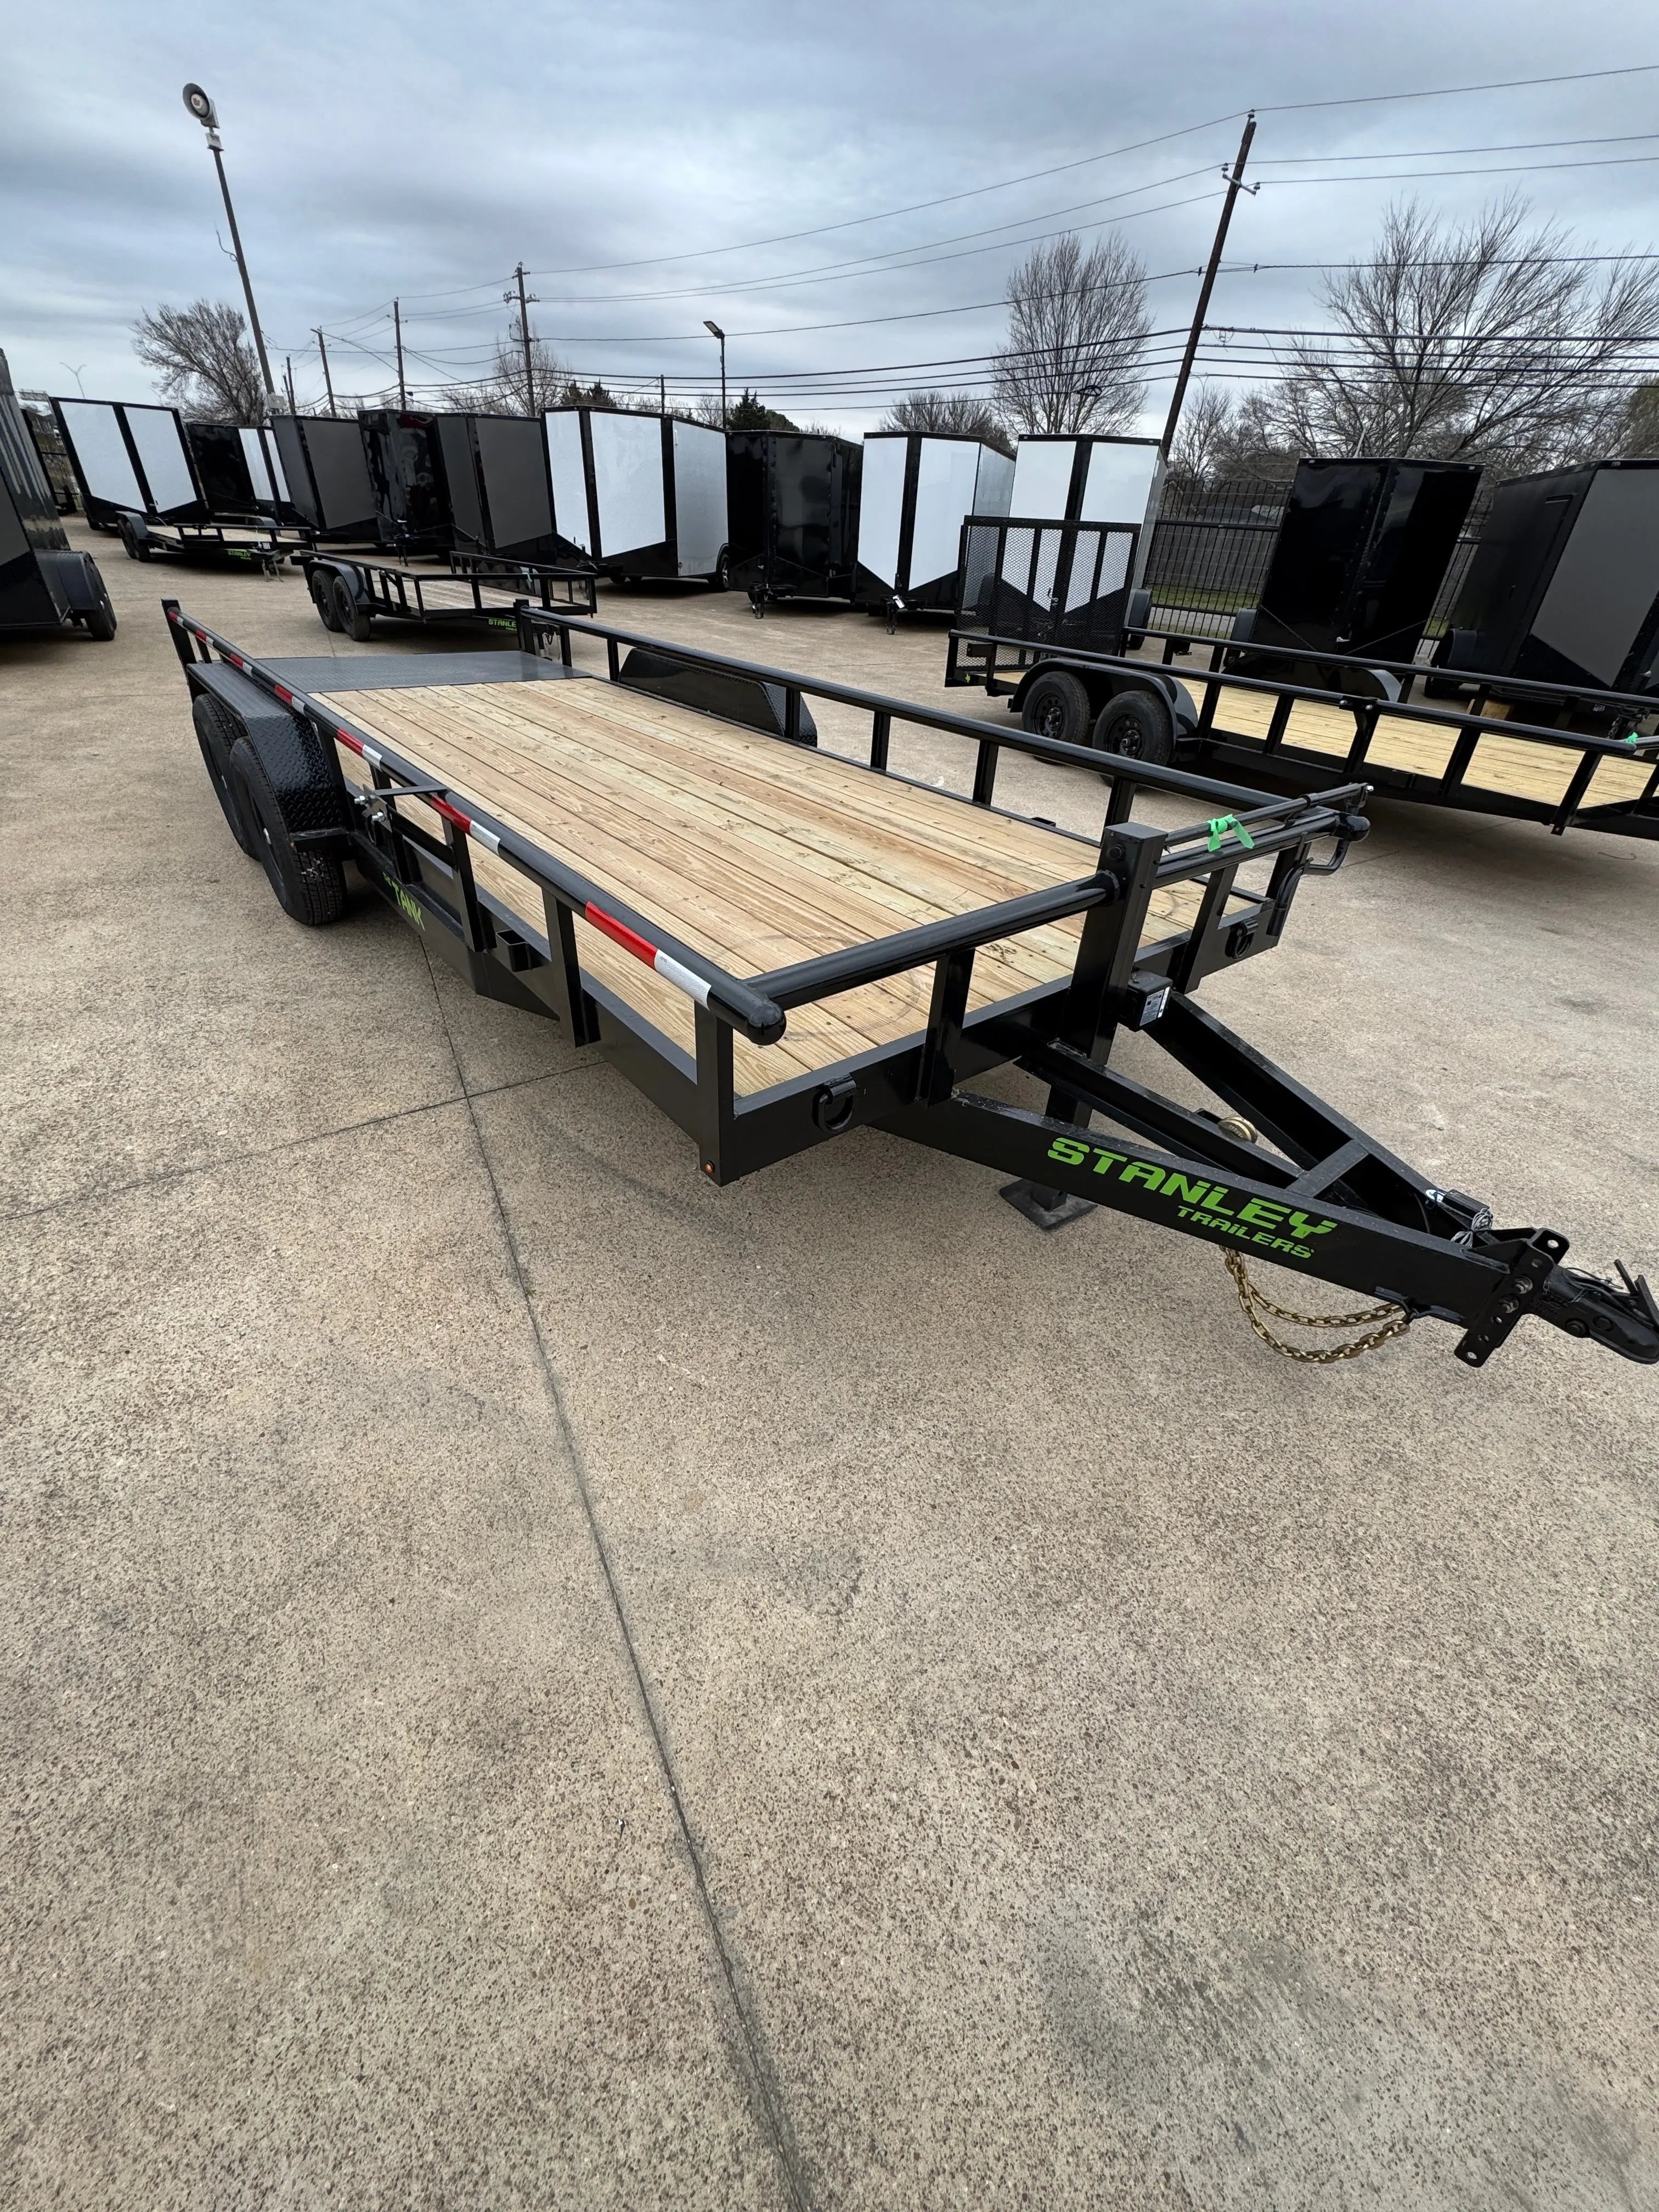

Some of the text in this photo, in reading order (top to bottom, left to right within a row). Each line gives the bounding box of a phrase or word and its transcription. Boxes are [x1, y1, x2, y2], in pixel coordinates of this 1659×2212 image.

[488, 619, 517, 627] STANLE
[391, 880, 425, 931] TANK
[1047, 1137, 1338, 1239] STANLEY
[1177, 1205, 1312, 1259] TRAILERS
